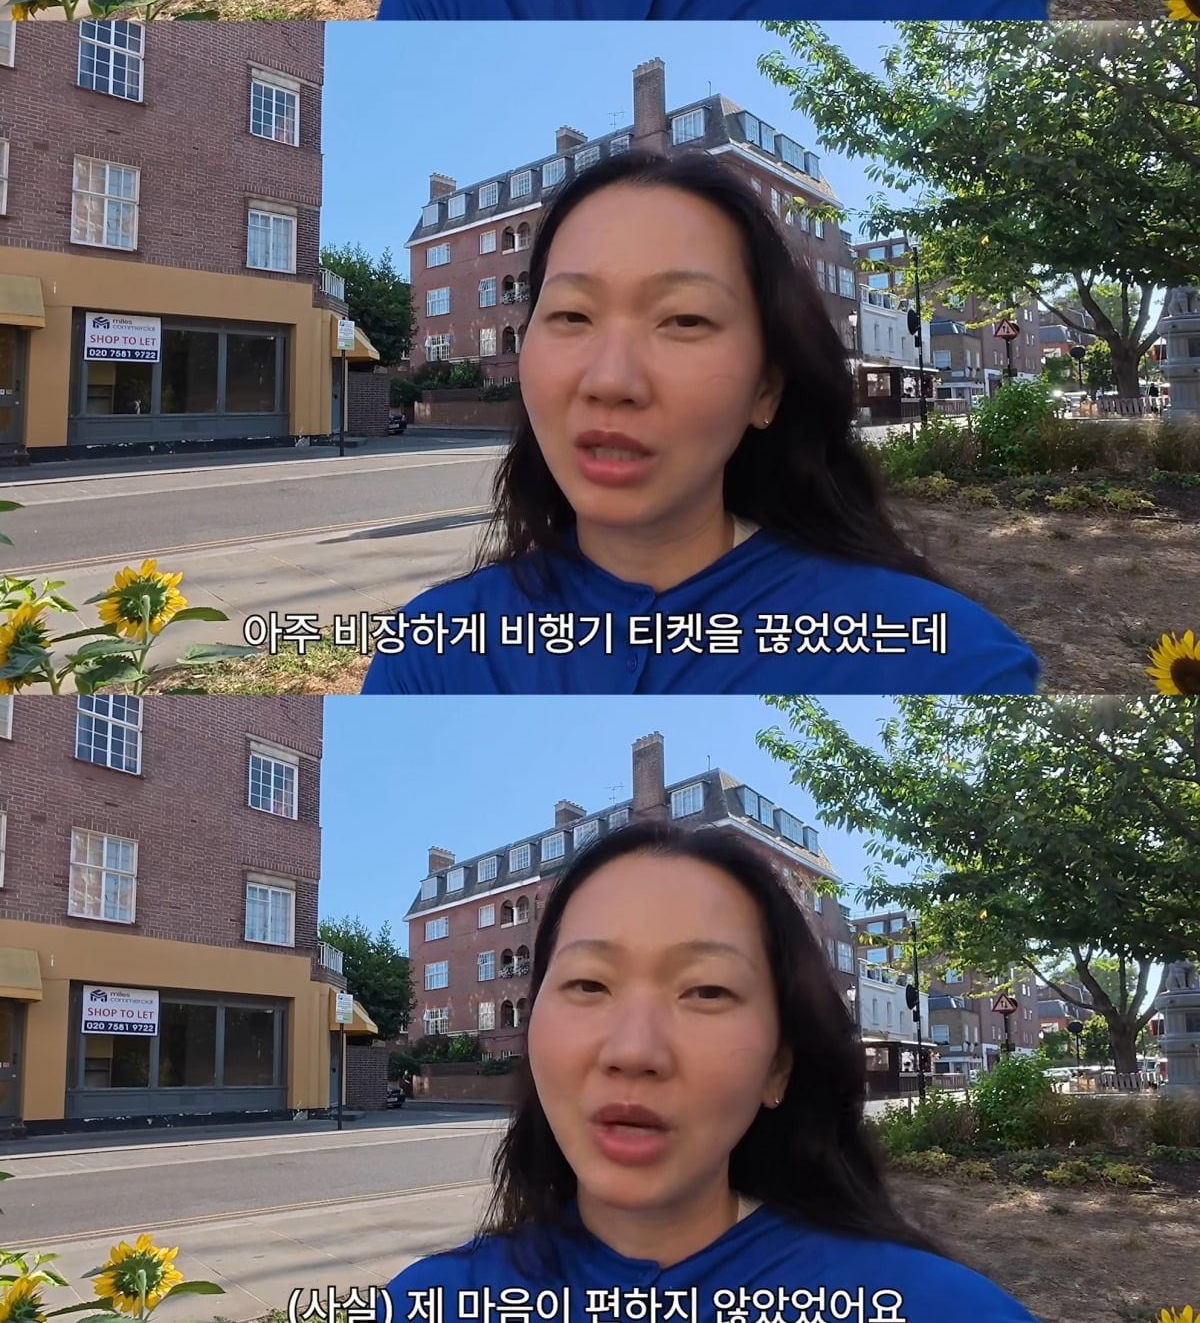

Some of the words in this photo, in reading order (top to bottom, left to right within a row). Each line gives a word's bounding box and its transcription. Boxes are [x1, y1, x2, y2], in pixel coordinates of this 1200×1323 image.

[90, 334, 120, 344] SHOP
[122, 336, 137, 345] TO
[139, 337, 157, 346] LET
[89, 349, 107, 357] 020
[110, 350, 131, 358] 7581
[134, 351, 156, 359] 9722
[87, 1007, 118, 1017] SHOP
[120, 1009, 135, 1018] TO
[137, 1010, 154, 1019] LET
[86, 1022, 105, 1030] 020
[107, 1023, 129, 1031] 7581
[132, 1024, 154, 1032] 9722
